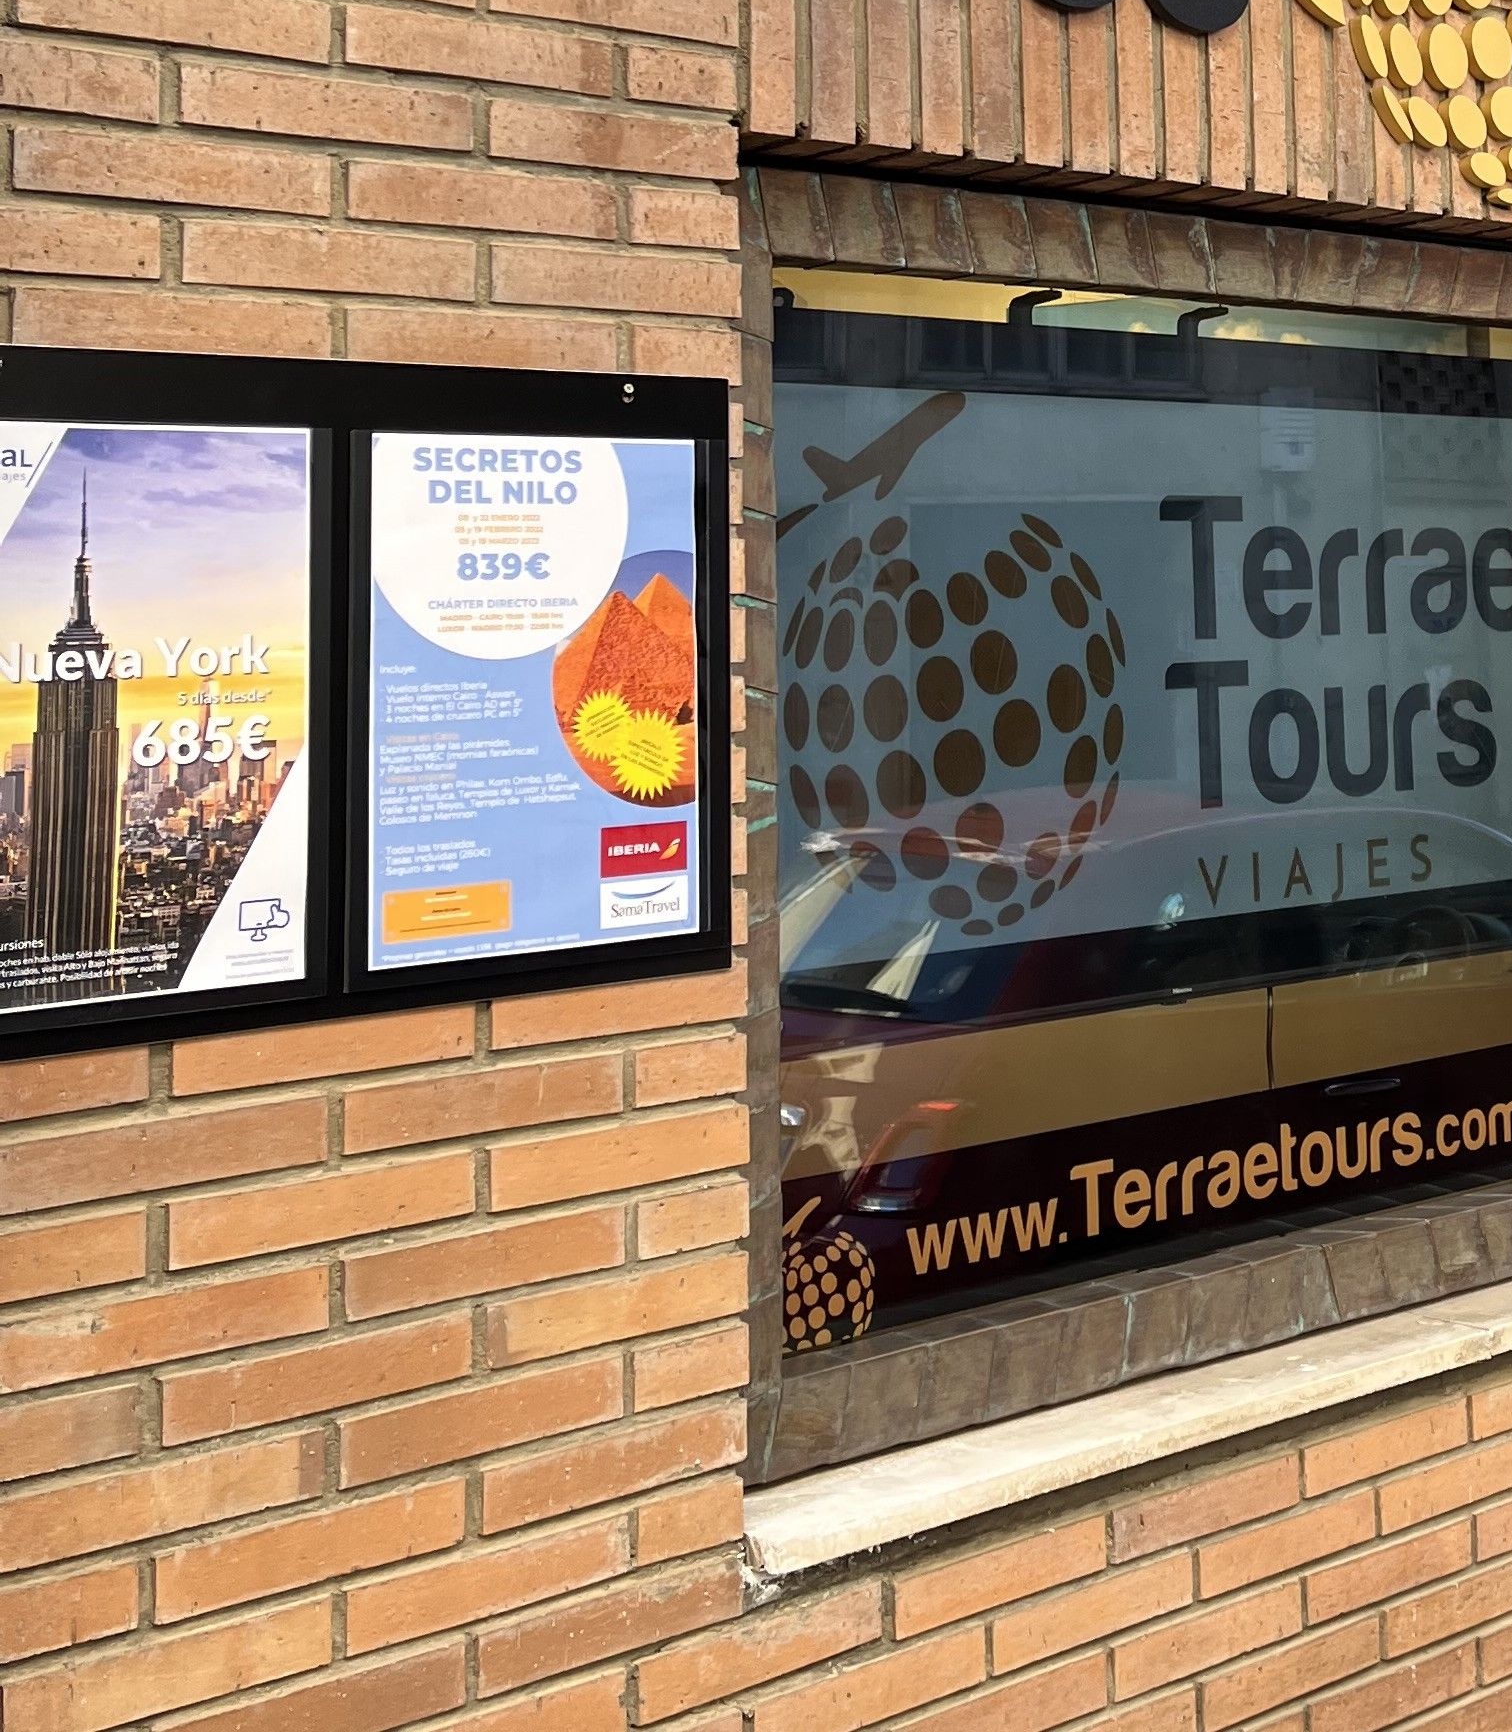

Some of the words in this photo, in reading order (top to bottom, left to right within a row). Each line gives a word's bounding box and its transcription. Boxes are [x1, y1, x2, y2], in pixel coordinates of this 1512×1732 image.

[413, 446, 583, 474] SECRETOS
[428, 479, 492, 505] DEL
[503, 480, 577, 505] NILO
[457, 552, 551, 581] 839€
[428, 596, 483, 610] CHÁRTER
[486, 597, 538, 609] DIRECTO
[540, 597, 578, 608] IBERIA
[153, 634, 271, 677] York
[177, 692, 187, 706] 5
[191, 689, 219, 705] días
[132, 714, 271, 767] 685€
[1165, 659, 1498, 809] Tours
[607, 841, 660, 857] IBERIA
[1197, 833, 1433, 907] VIAJES
